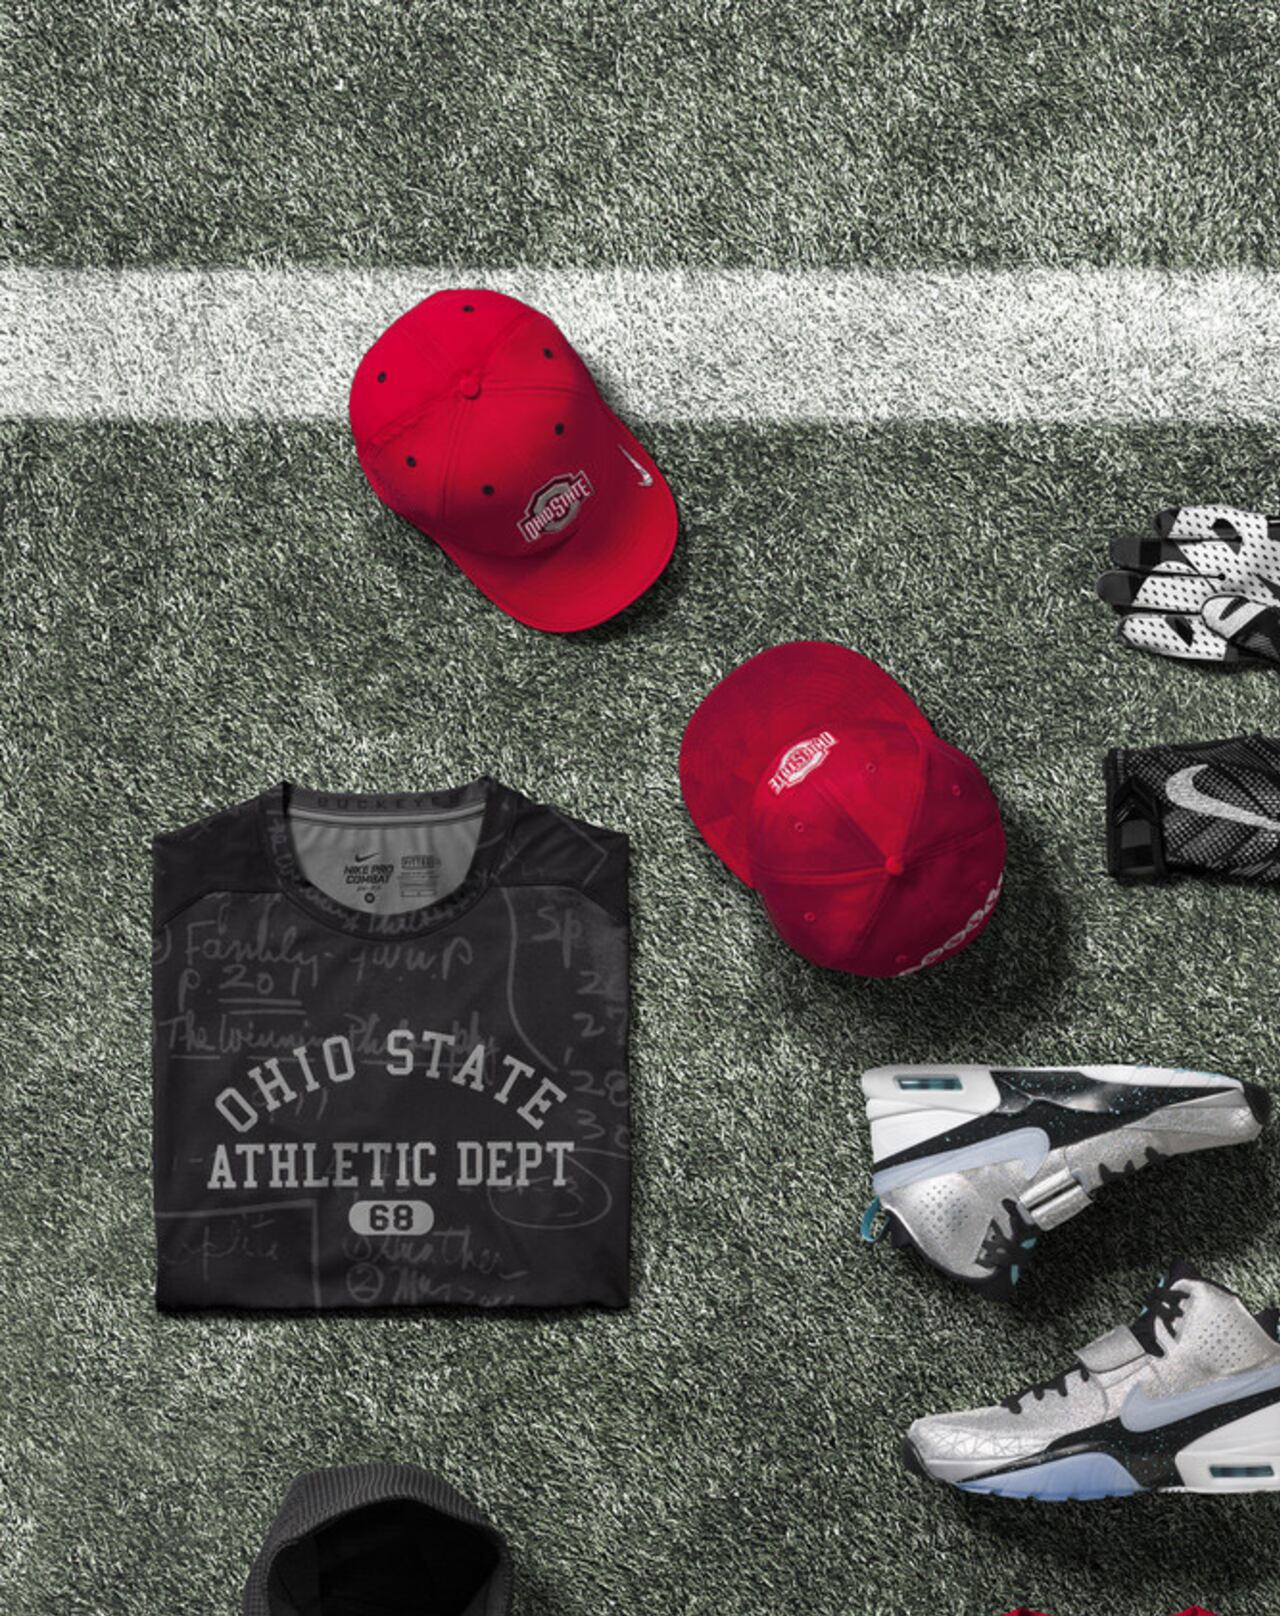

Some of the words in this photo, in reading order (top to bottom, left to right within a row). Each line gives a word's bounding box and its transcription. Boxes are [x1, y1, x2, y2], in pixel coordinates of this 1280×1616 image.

[214, 1034, 356, 1133] OHIO
[386, 1028, 568, 1131] STATE
[206, 1141, 437, 1189] ATHLETIC
[457, 1141, 575, 1187] DEPT
[369, 1204, 414, 1231] 68
